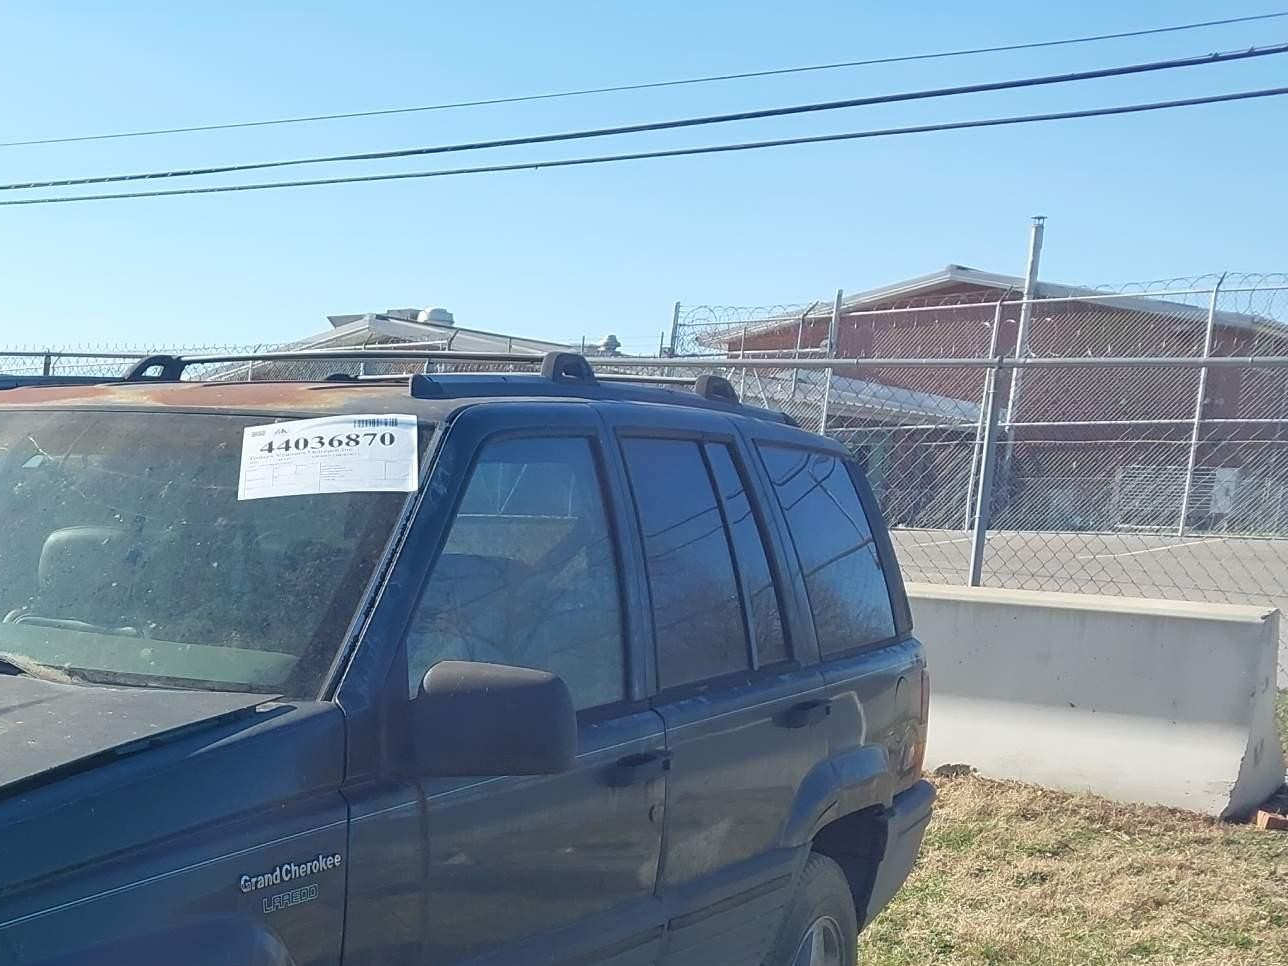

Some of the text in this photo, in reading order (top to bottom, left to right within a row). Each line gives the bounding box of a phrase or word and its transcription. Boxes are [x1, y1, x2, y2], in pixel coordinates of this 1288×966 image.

[259, 431, 396, 454] 44036870
[240, 854, 342, 893] Grand Cherokee
[262, 883, 319, 913] LAREDO
